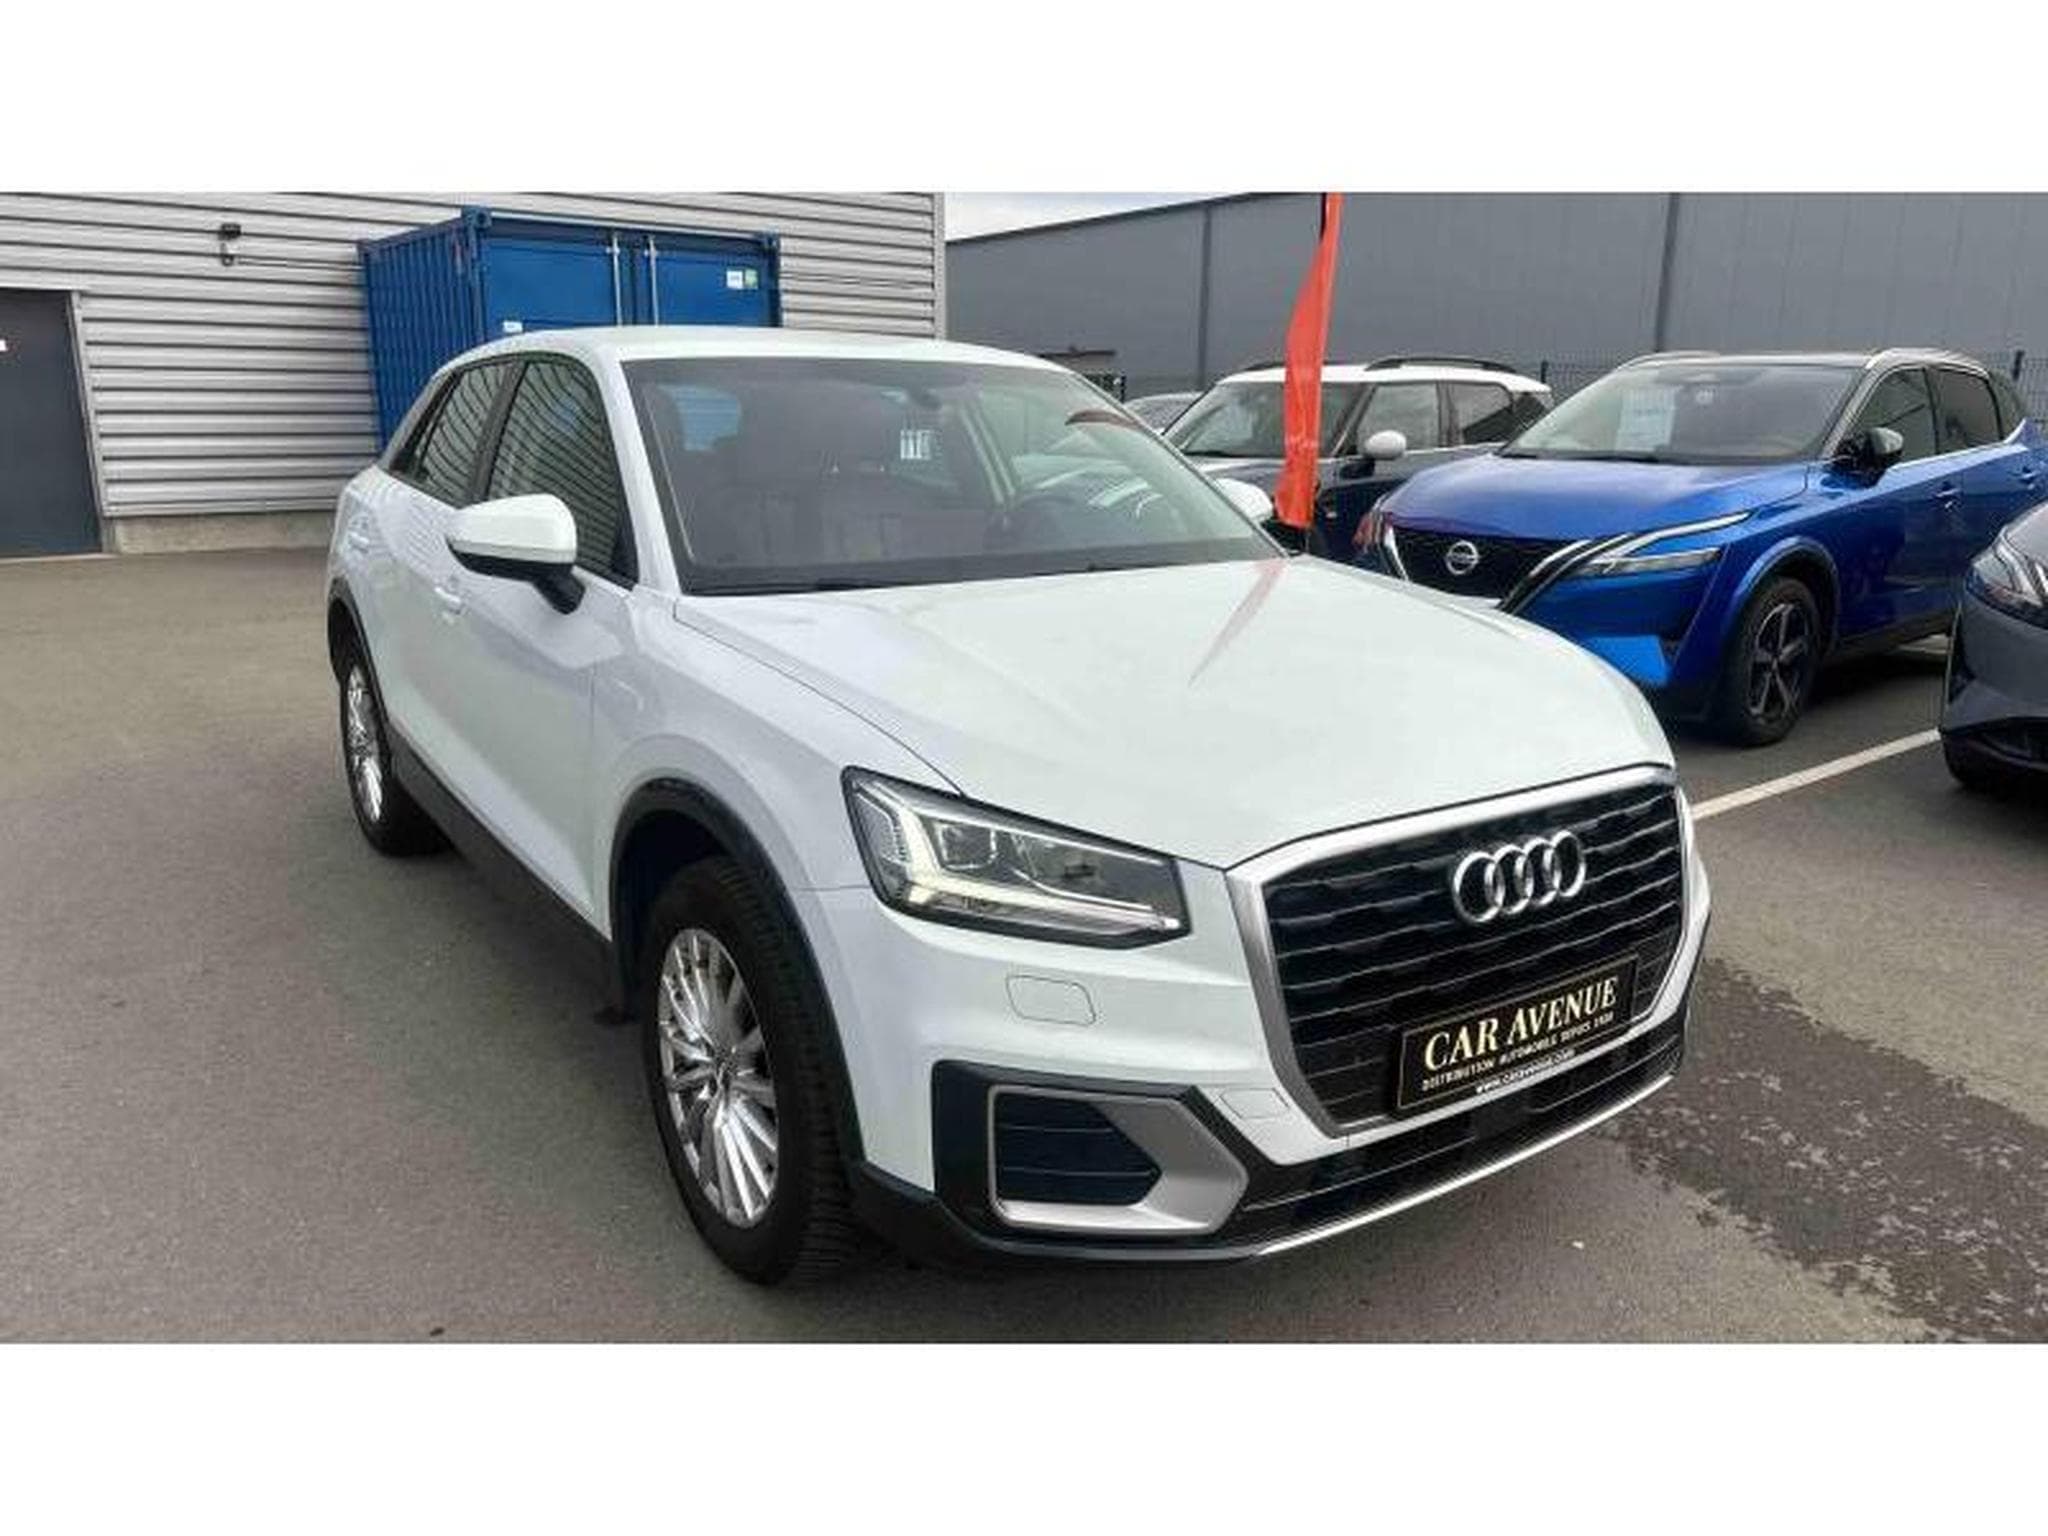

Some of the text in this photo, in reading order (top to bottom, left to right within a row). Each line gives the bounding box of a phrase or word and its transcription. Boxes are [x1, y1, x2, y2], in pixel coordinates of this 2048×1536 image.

[1425, 976, 1618, 1071] CAR AVENUE
[1422, 1057, 1494, 1091] DISTRIBUTION
[1499, 1034, 1557, 1065] AUTOMOBILE
